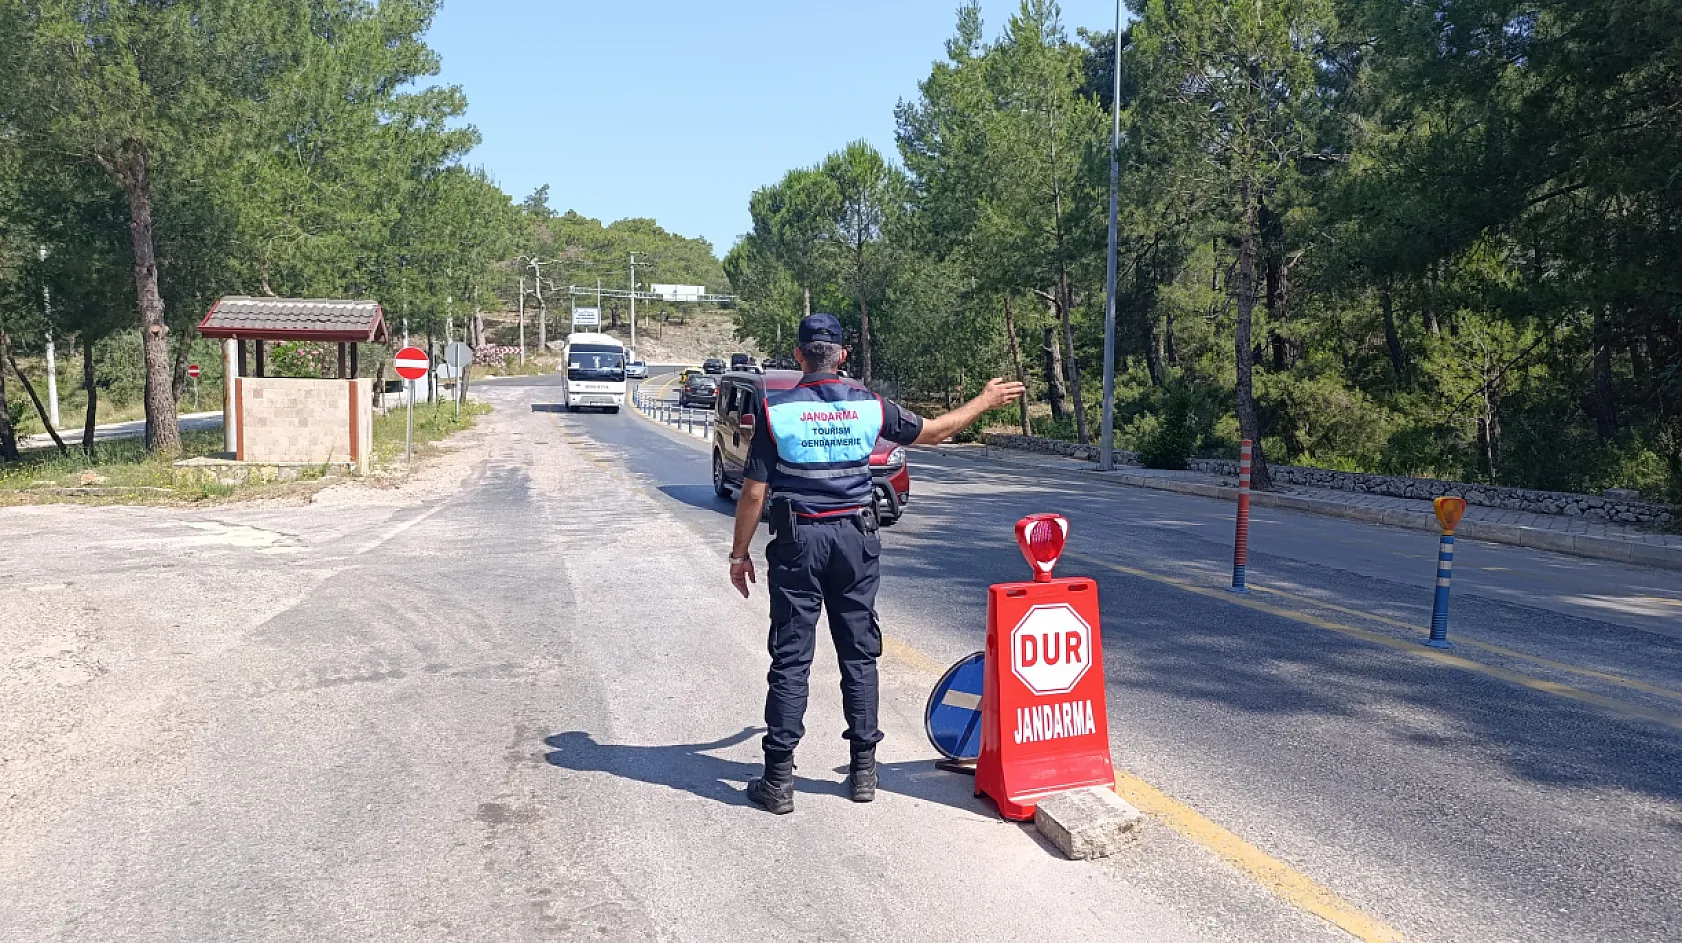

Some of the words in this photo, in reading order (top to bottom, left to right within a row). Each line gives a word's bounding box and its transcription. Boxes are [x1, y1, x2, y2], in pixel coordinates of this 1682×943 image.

[800, 410, 859, 422] JANDARMA
[812, 427, 851, 435] TOURISM
[801, 438, 861, 448] GENDARMERIE
[1021, 631, 1082, 668] DUR
[1014, 699, 1096, 745] JANDARMA
